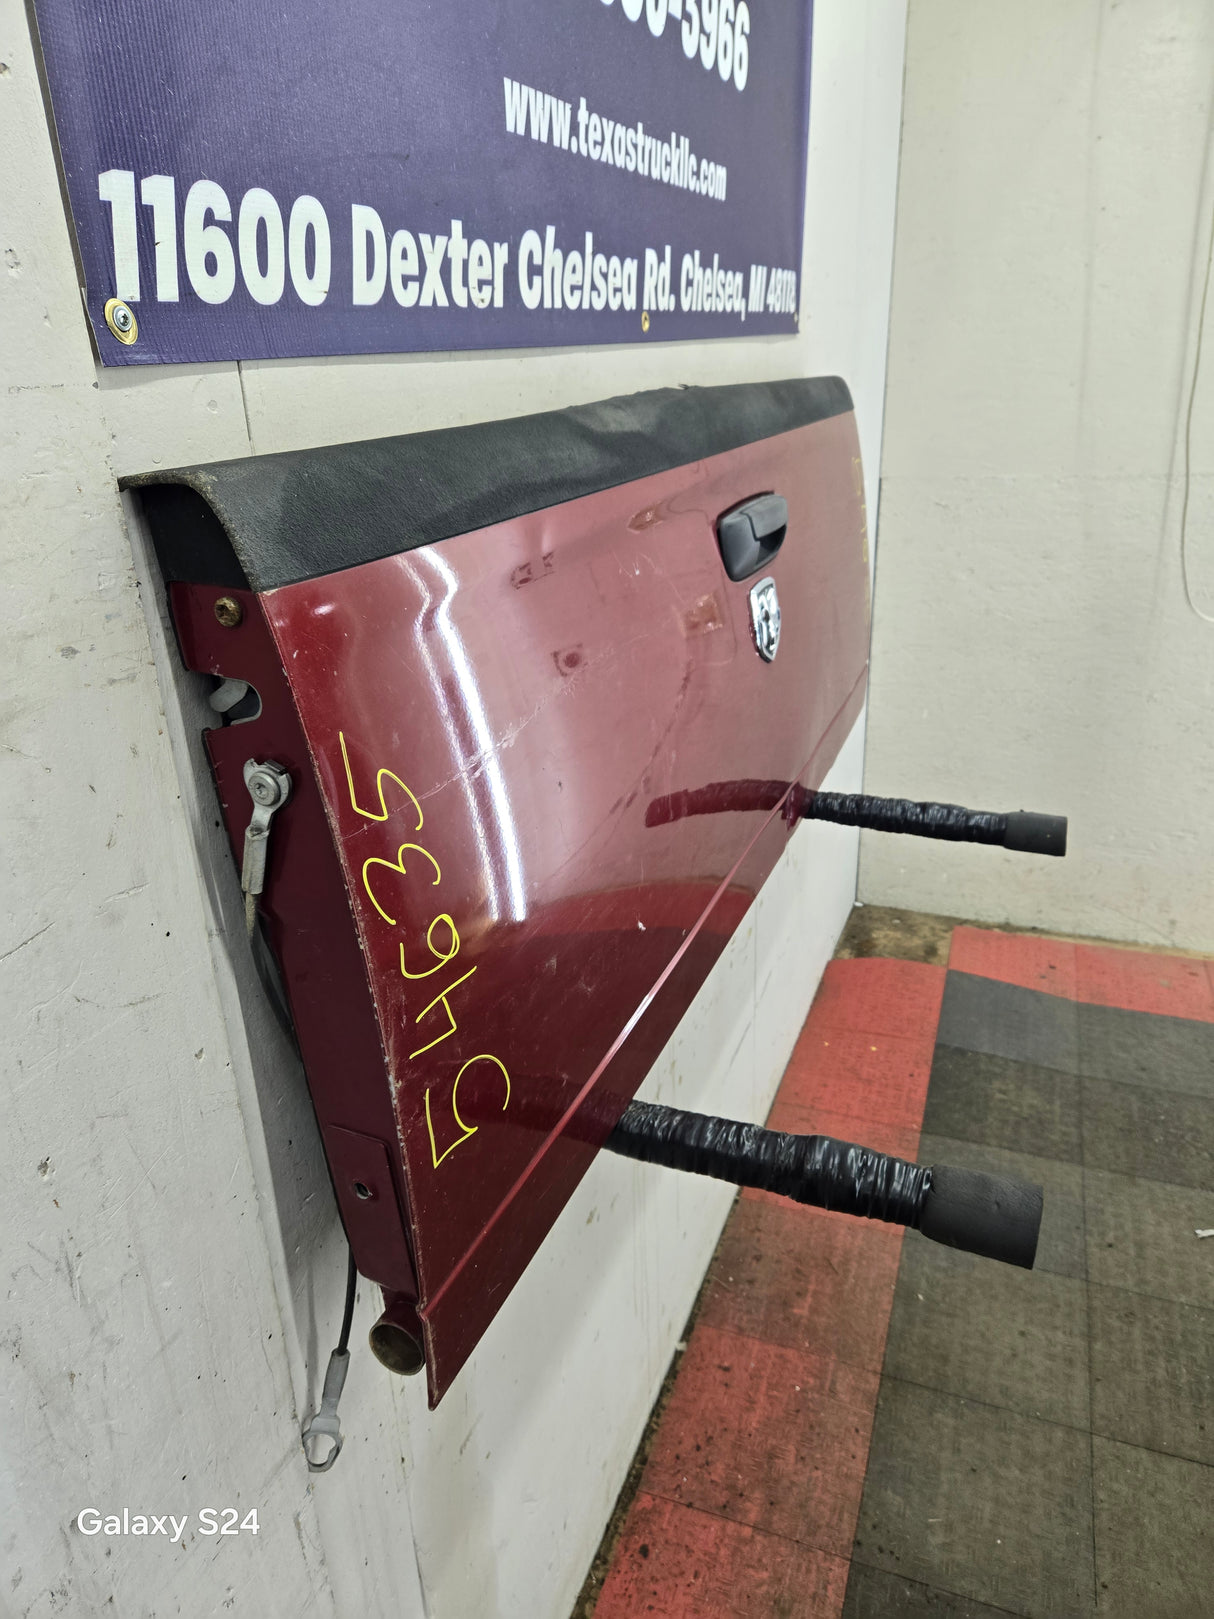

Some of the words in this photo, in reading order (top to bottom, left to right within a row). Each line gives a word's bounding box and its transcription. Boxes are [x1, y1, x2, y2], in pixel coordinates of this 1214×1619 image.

[503, 76, 728, 202] www.texastruckllc.com
[98, 169, 332, 306] 11600
[351, 203, 509, 309] Dexter
[518, 224, 639, 312] Chelsea
[643, 244, 676, 312] Rd.
[680, 249, 746, 322] Chelsea,
[747, 264, 767, 313] MI
[338, 730, 511, 1169] 54635
